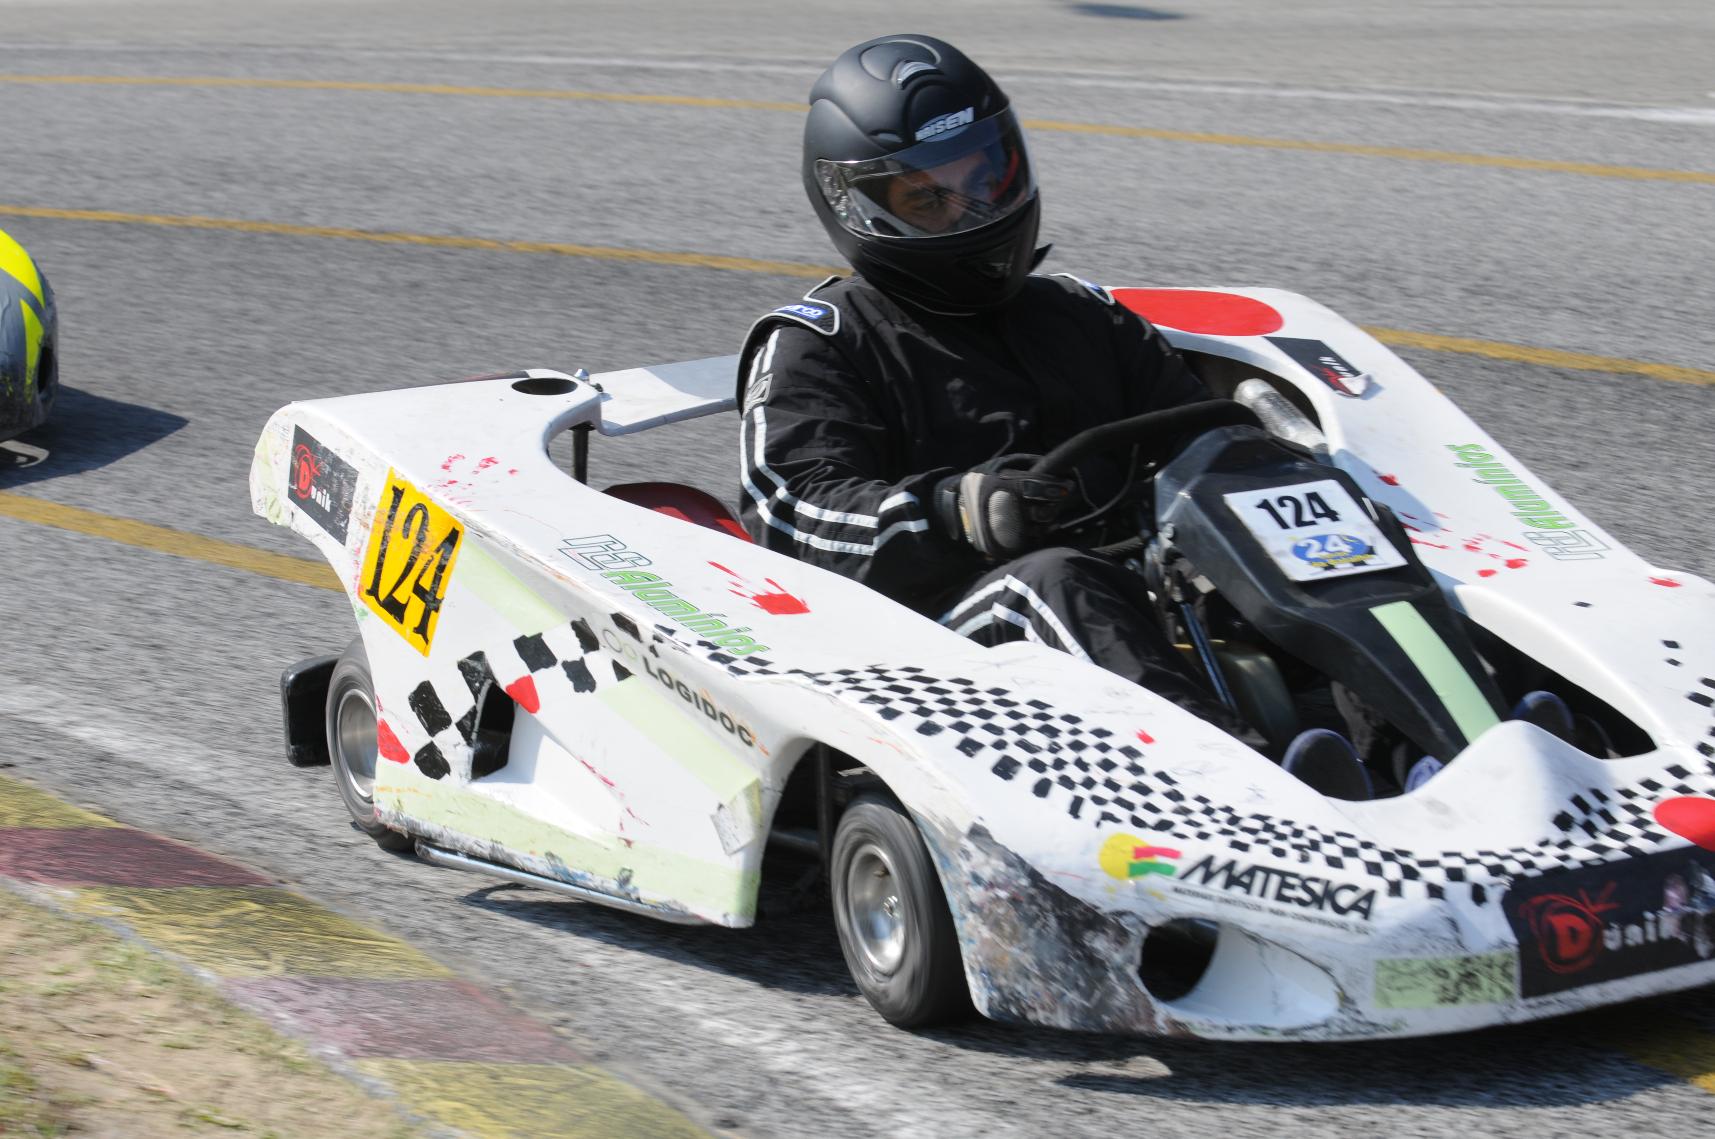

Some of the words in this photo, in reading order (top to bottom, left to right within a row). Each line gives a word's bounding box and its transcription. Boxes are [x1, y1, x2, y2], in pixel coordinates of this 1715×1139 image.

[1255, 491, 1342, 530] 124
[365, 485, 461, 645] 124
[1296, 534, 1353, 559] 24
[642, 655, 756, 748] LOGIDOC
[1179, 854, 1379, 921] MATESICA
